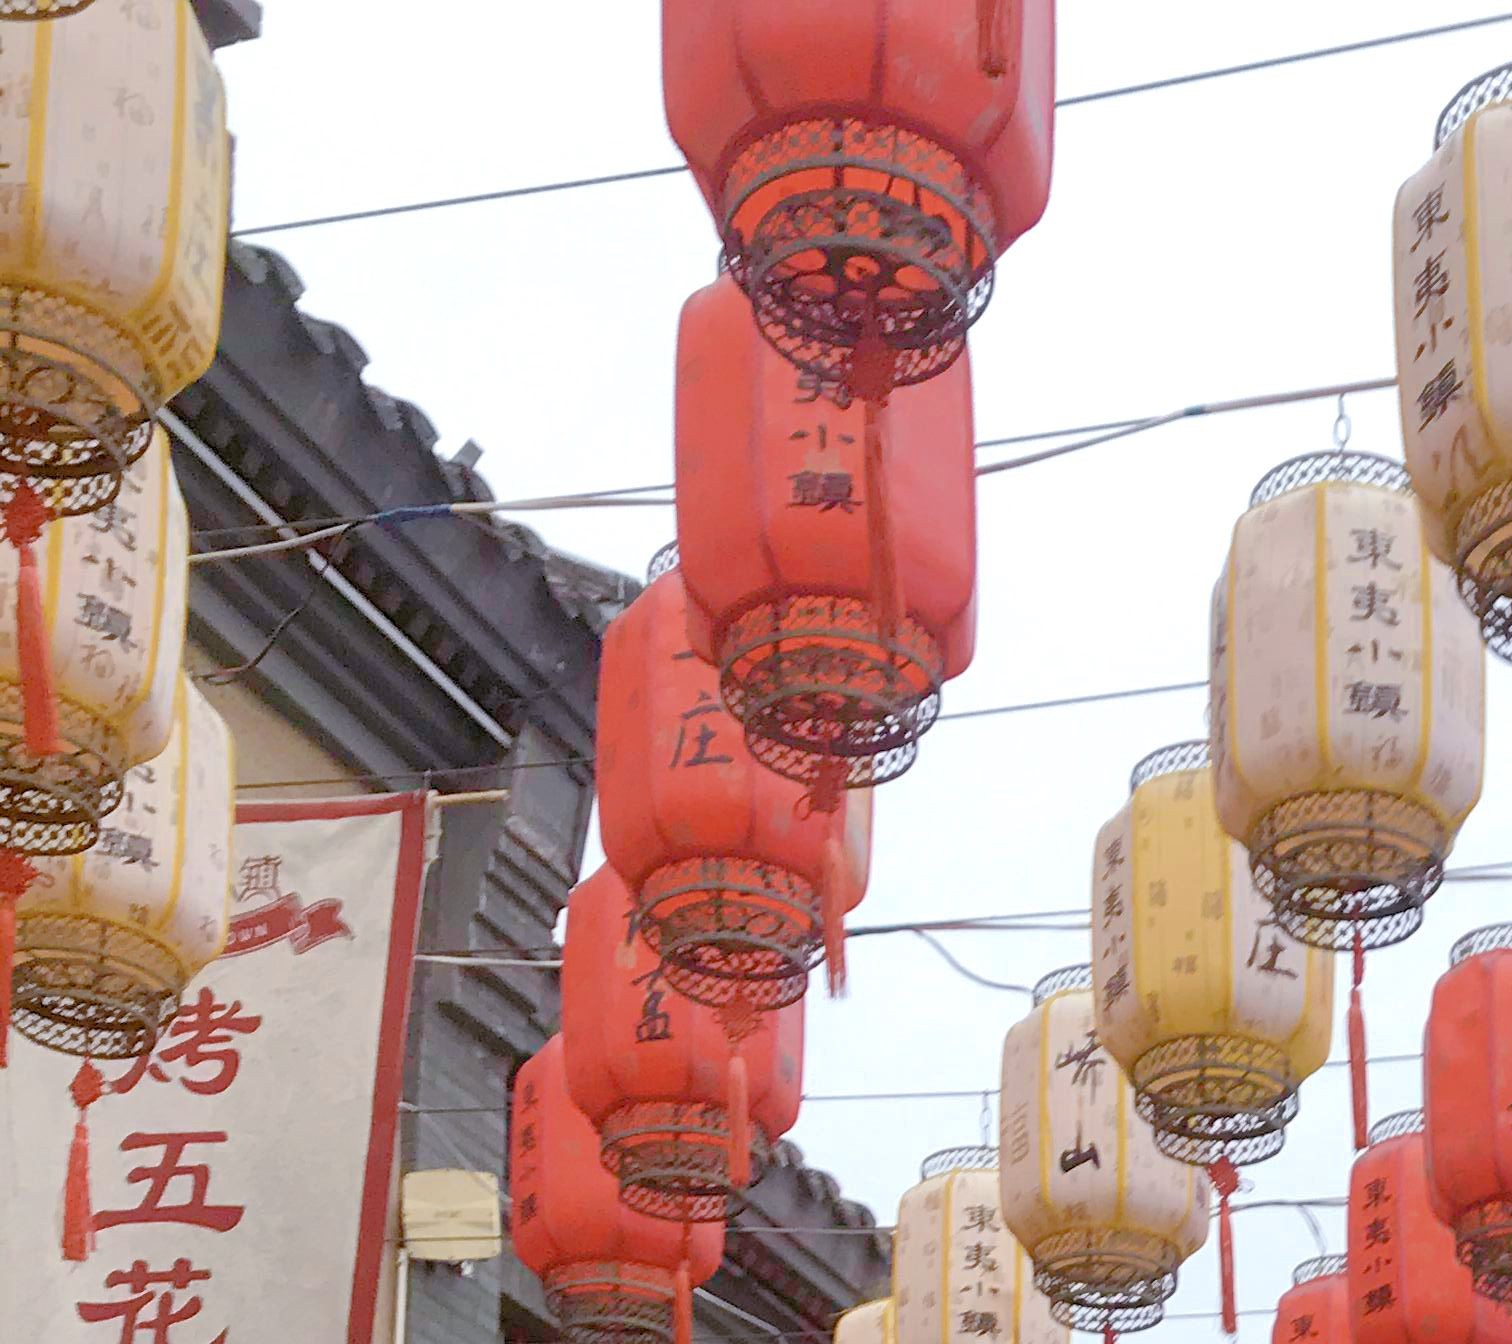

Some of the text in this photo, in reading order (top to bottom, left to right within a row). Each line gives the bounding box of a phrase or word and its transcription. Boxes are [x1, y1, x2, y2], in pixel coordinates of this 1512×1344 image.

[1411, 182, 1464, 433] 東夷小鎮
[786, 373, 865, 513] 夷小鎮
[76, 462, 146, 656] 夷小鎮
[1343, 528, 1410, 721] 東夷小鎮
[1099, 834, 1129, 1016] 東夷小鎮
[959, 1202, 1002, 1340] 東夷小鎮
[1362, 1175, 1397, 1319] 東夷小鎮
